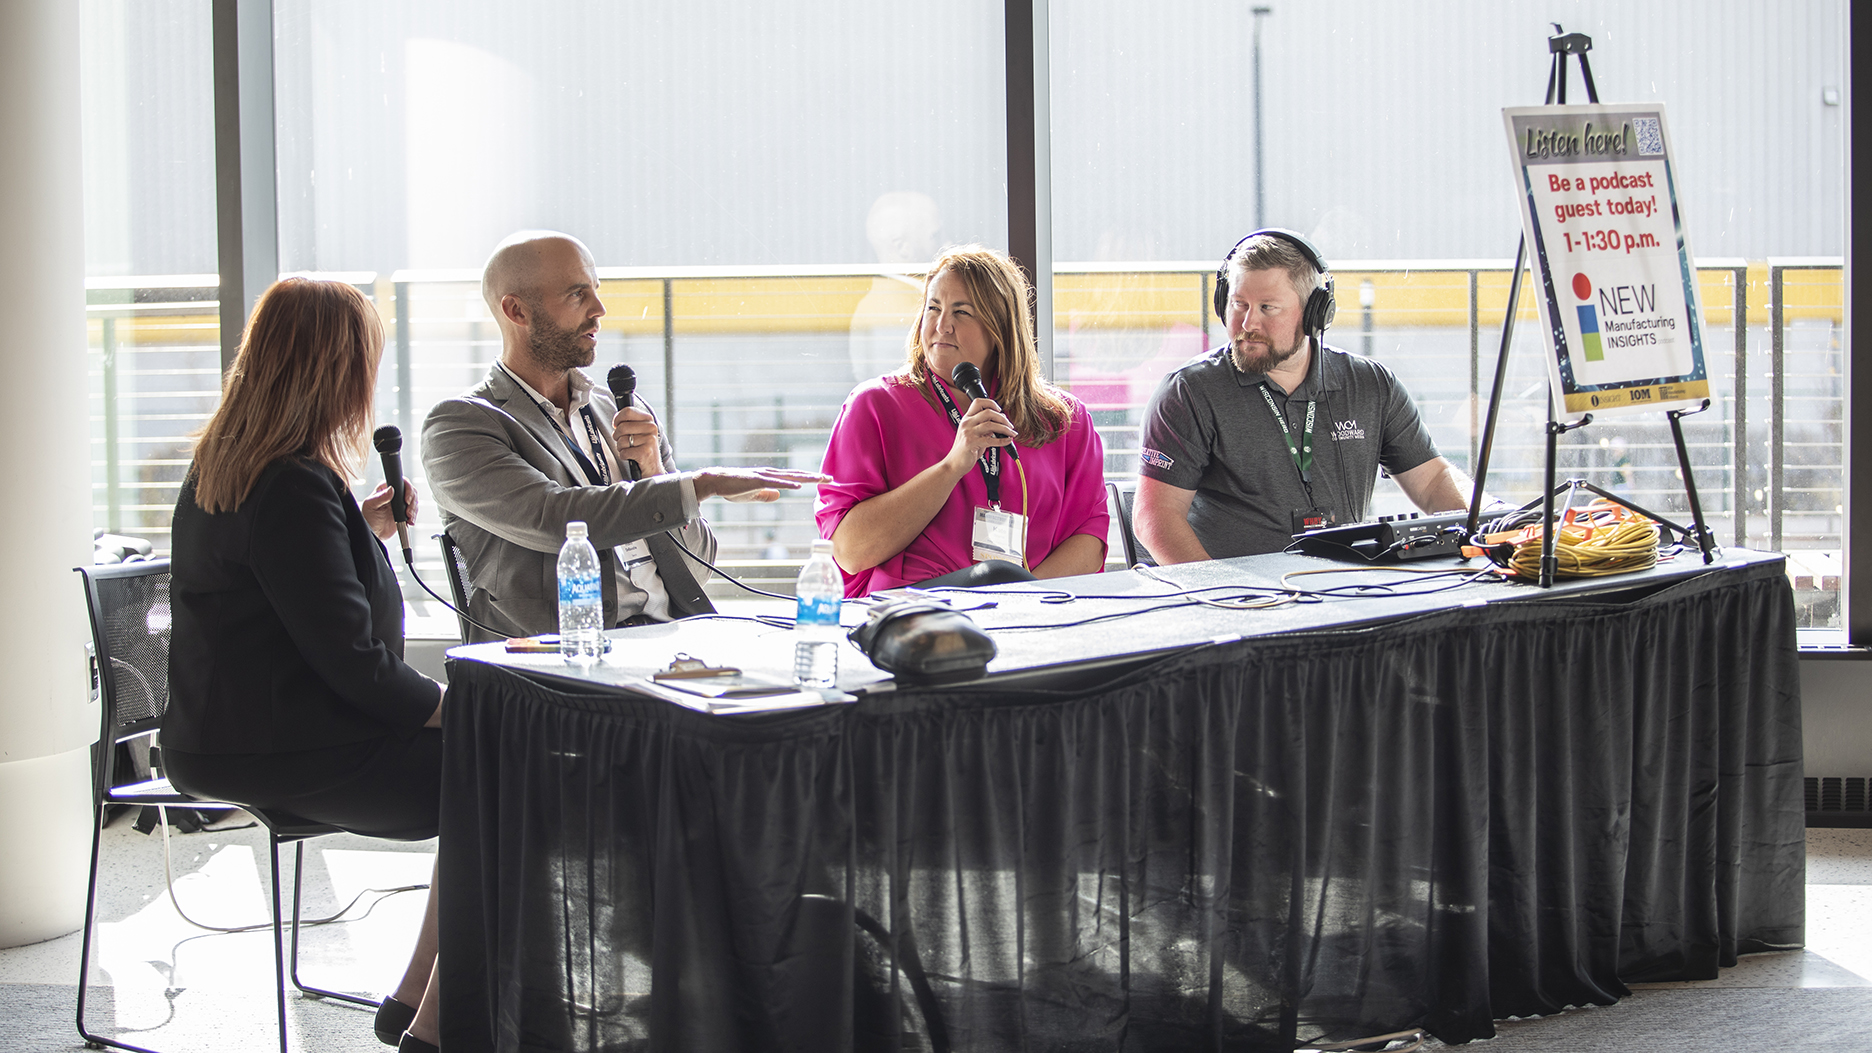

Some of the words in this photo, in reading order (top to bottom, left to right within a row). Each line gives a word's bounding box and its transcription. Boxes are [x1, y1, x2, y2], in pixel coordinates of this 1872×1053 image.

[1525, 127, 1579, 159] Listen
[1583, 121, 1629, 155] here!
[1547, 174, 1571, 192] Be
[1575, 177, 1585, 191] a
[1589, 171, 1654, 195] podcast
[1554, 200, 1602, 223] guest
[1607, 195, 1657, 218] today!
[1624, 233, 1660, 254] p.m.
[1599, 284, 1655, 316] NEW
[1605, 316, 1675, 332] Manufacturing
[1607, 332, 1657, 348] INSIGHTS
[1629, 388, 1651, 400] IOM
[1259, 384, 1281, 416] WISCONSIN
[1277, 416, 1289, 433] HERO
